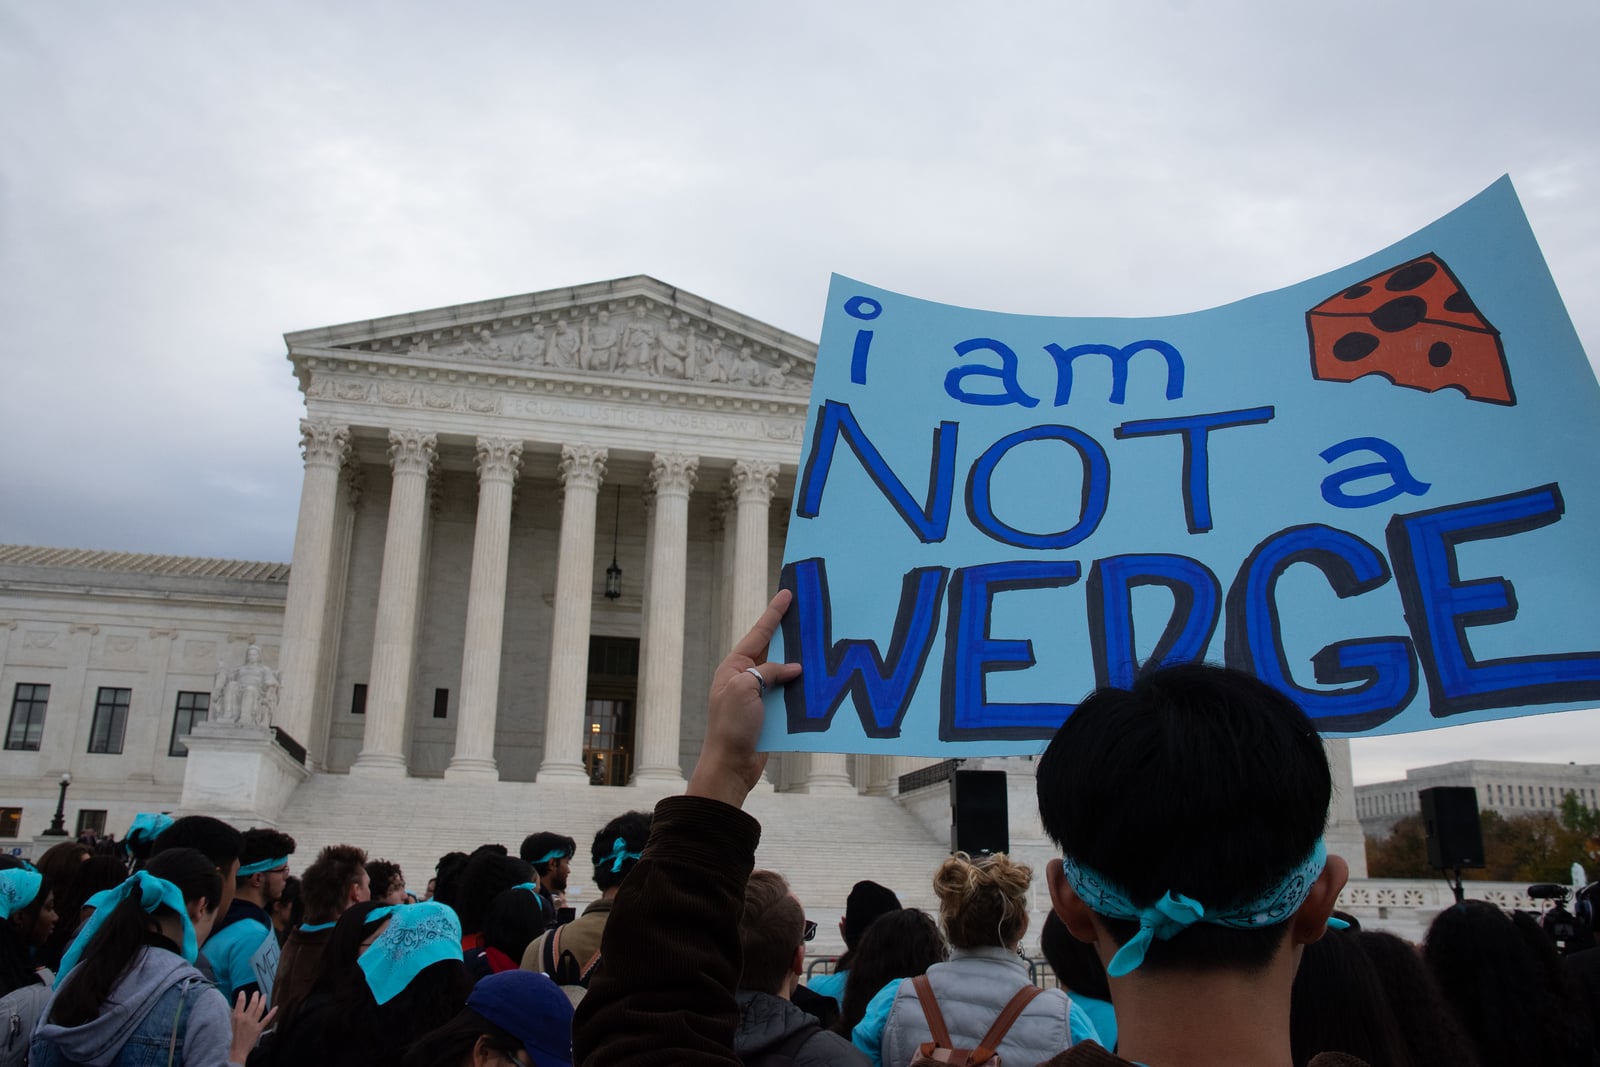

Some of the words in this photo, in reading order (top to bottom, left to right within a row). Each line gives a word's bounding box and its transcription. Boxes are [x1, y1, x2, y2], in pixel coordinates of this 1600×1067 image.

[514, 400, 577, 418] EQUAL
[577, 403, 645, 424] JUSTICE
[655, 415, 712, 430] UNDER
[718, 419, 750, 433] LAW
[844, 296, 882, 385] i
[944, 338, 1184, 408] am
[797, 399, 1275, 549] NOT
[1319, 437, 1431, 508] a
[779, 483, 1600, 741] WEDGE
